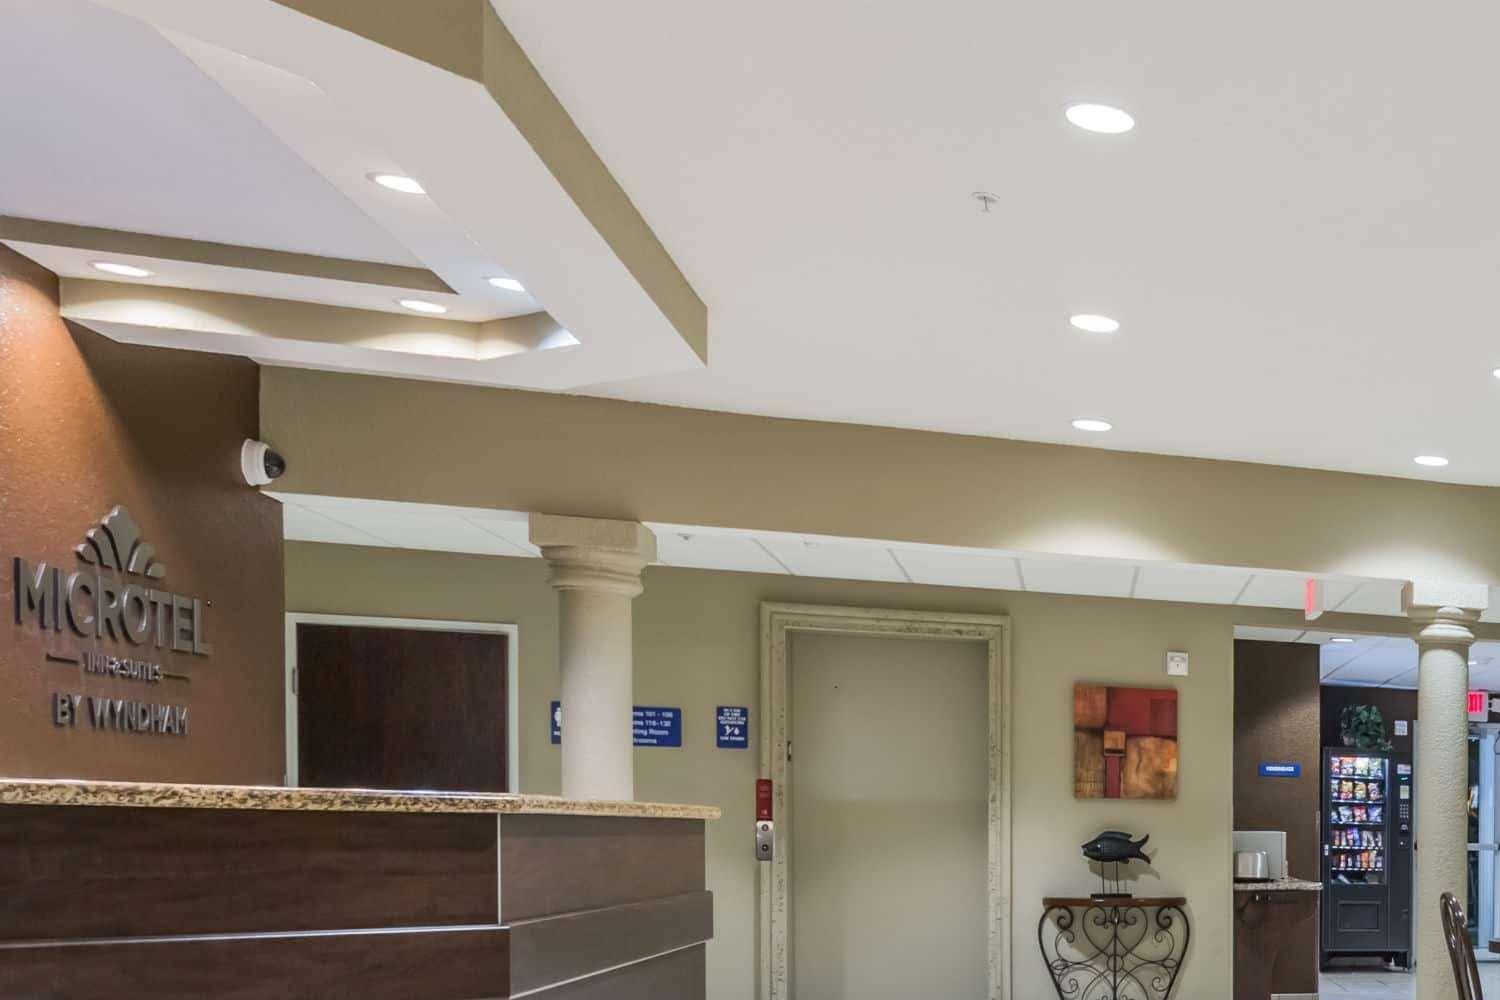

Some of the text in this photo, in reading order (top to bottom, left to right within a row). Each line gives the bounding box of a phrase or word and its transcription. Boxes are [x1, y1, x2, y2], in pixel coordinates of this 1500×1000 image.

[13, 556, 212, 658] MICROTEL
[53, 691, 190, 735] BY WYNDHAM
